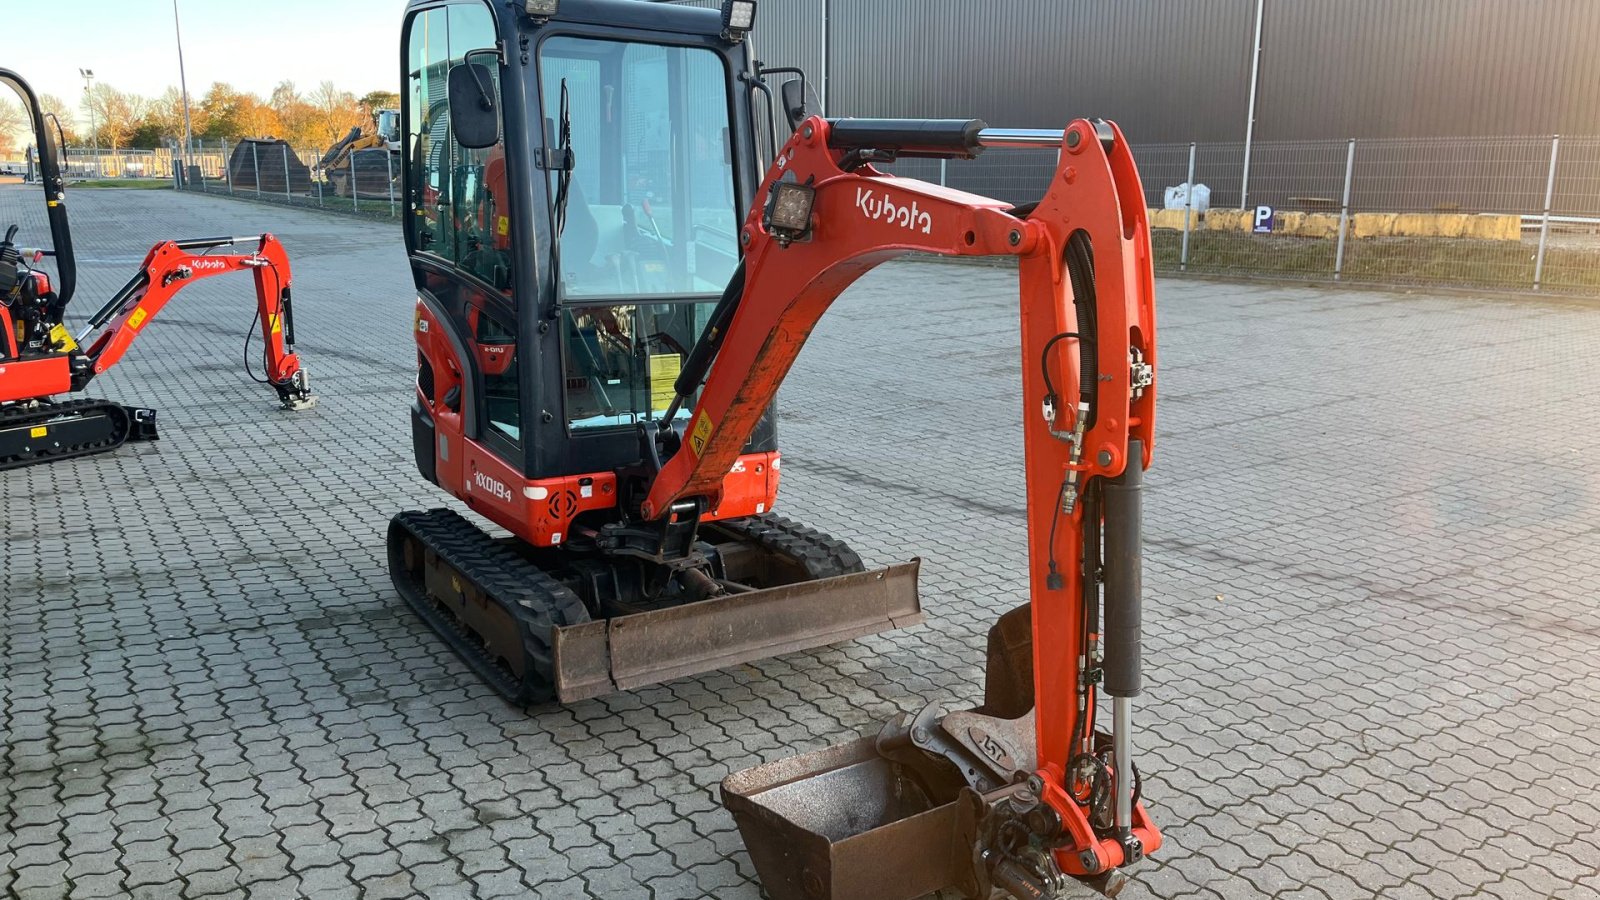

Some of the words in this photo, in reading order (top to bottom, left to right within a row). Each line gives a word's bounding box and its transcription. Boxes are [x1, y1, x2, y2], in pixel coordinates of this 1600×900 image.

[856, 187, 931, 234] Kubota
[1255, 205, 1272, 226] P
[192, 259, 225, 269] Kubota
[475, 470, 511, 502] KX019-4
